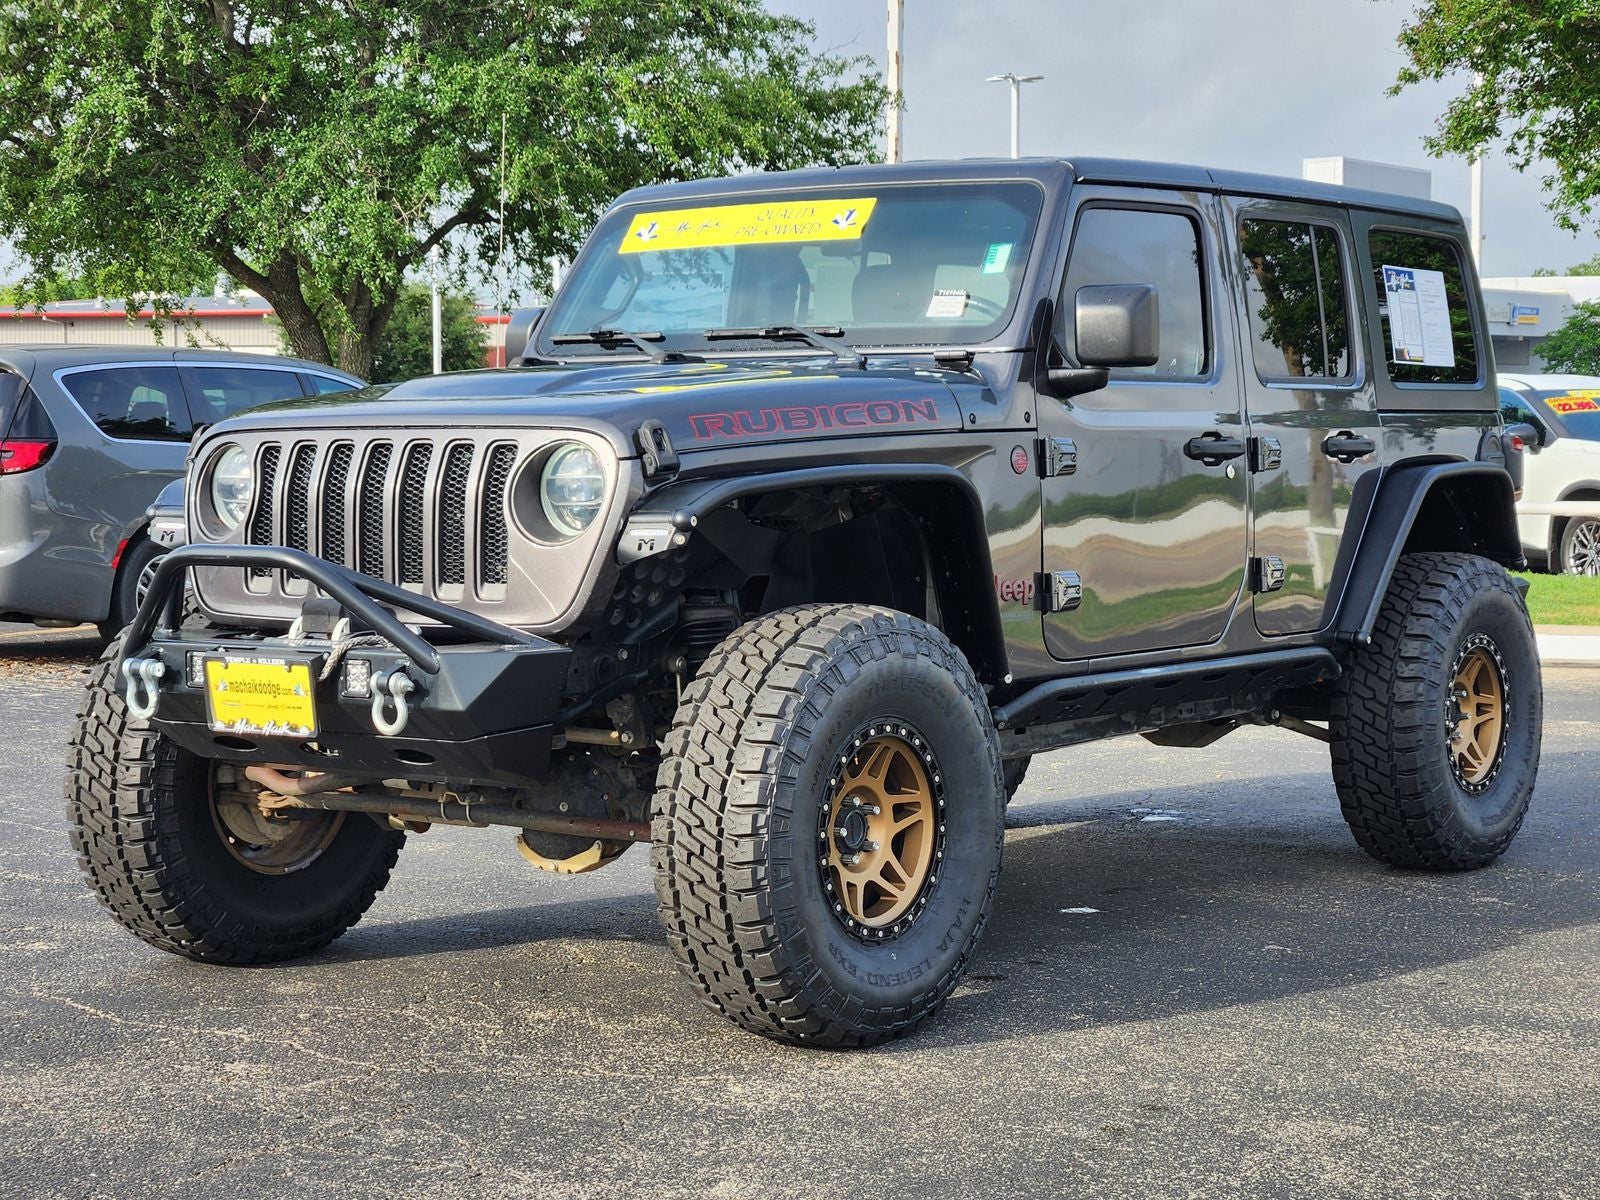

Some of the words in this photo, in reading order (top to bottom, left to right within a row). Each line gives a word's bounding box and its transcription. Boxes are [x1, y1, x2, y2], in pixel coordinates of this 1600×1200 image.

[756, 206, 820, 222] QUALITY
[734, 222, 822, 238] PRE-OWNED
[688, 399, 939, 441] RUBICON
[225, 656, 251, 664] TEMPLE
[234, 718, 258, 734] Mac
[866, 959, 933, 987] LEGEND
